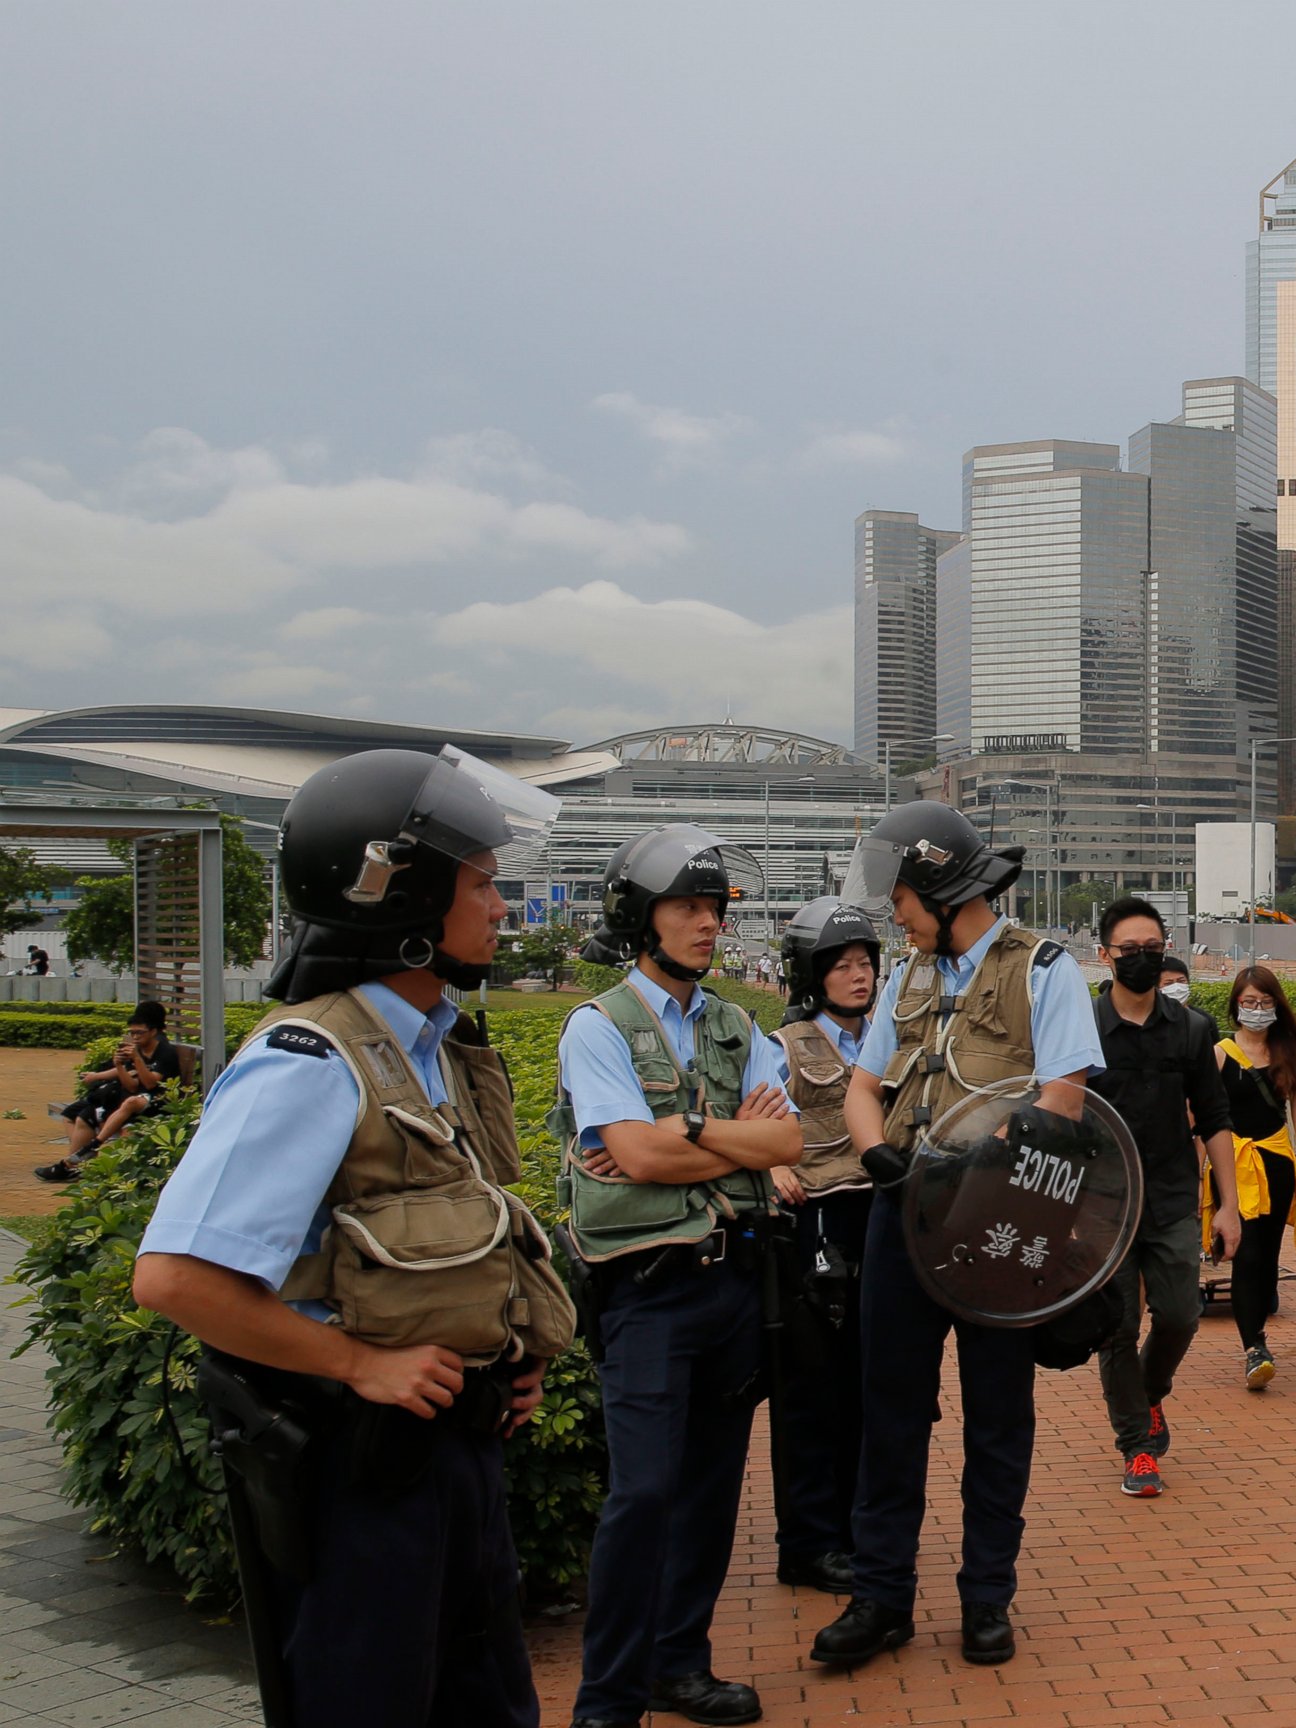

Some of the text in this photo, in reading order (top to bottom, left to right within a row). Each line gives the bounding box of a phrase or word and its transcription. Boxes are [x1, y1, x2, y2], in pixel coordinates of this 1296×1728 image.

[687, 858, 719, 870] Police
[833, 915, 861, 925] Police
[279, 1032, 318, 1046] 3262
[1008, 1145, 1085, 1205] POLICE
[980, 1222, 1051, 1269] 警察
